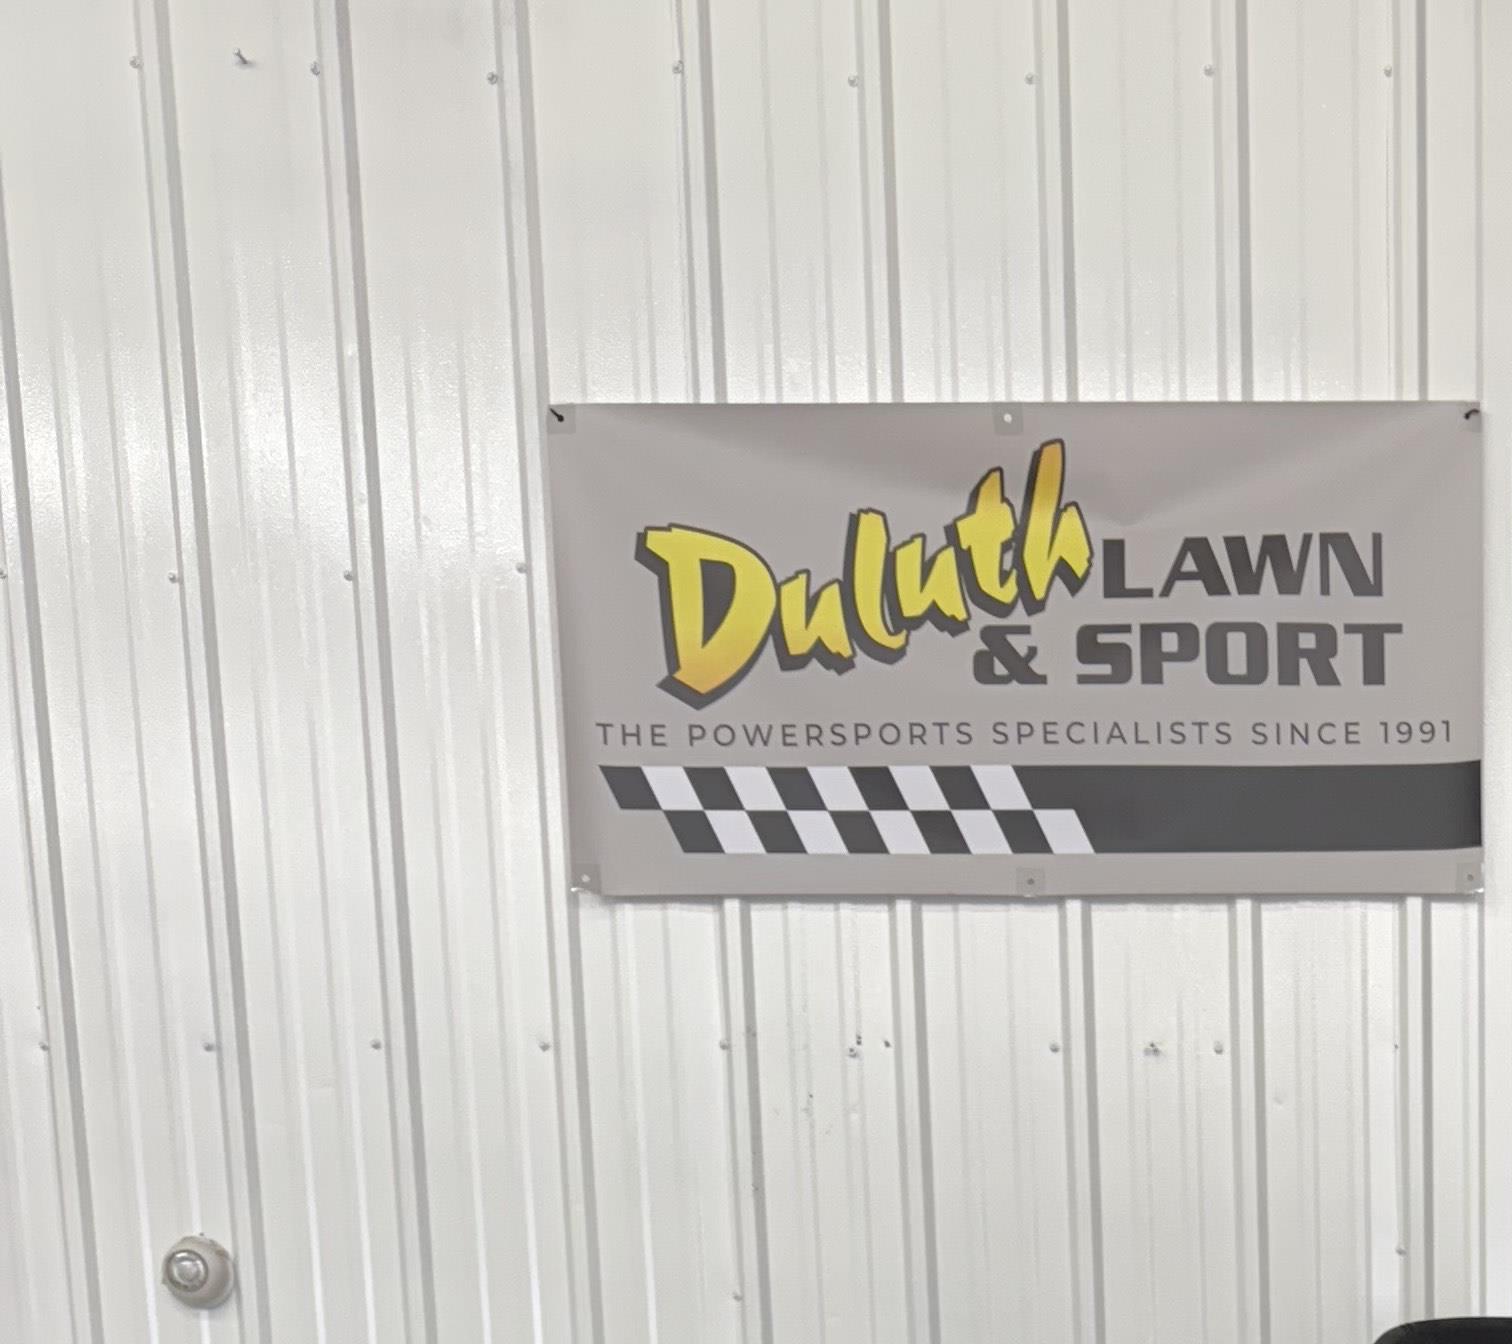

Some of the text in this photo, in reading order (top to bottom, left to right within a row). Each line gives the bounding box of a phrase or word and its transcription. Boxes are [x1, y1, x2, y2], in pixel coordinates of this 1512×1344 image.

[634, 438, 1384, 711] Duluth LAWN
[972, 621, 1404, 686] & SPORT
[595, 719, 1453, 748] THE POWERSPORTS SPECIALISTS SINCE 1991
